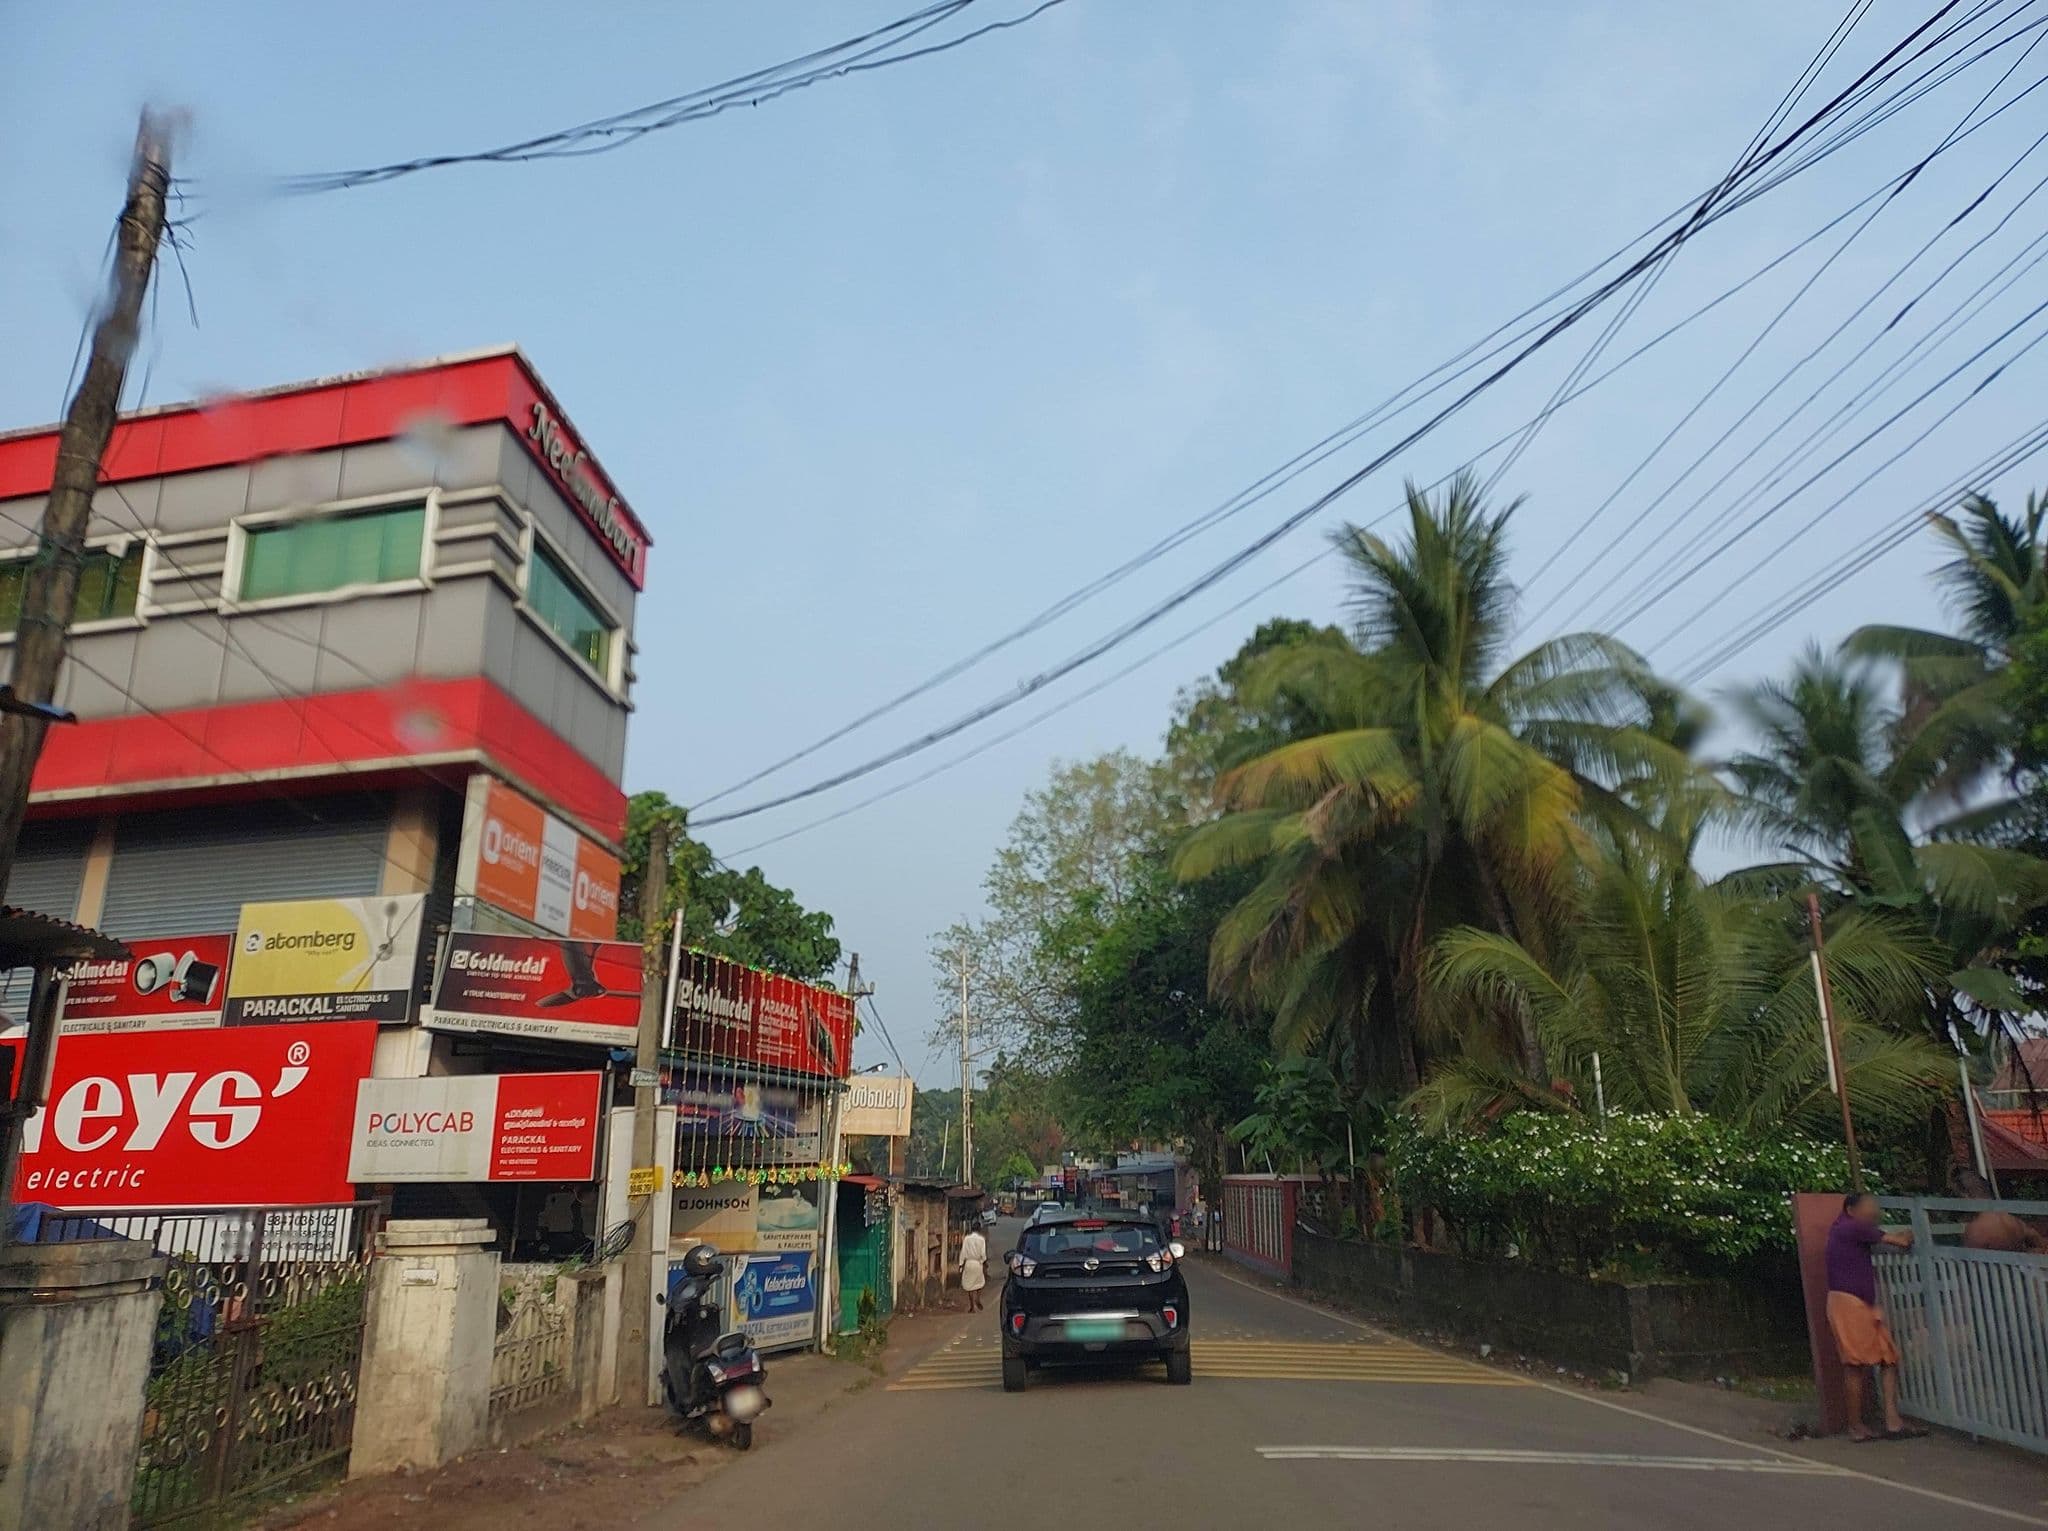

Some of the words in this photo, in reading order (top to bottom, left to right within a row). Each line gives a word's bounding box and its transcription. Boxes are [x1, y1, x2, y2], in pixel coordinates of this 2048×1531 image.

[265, 931, 355, 951] atomberg
[469, 952, 546, 975] Goldmedal
[242, 996, 334, 1018] PARACKAL
[336, 994, 382, 1004] ELECTRICALS
[335, 1004, 371, 1013] SANITARY
[693, 984, 752, 1022] Goldmedal
[63, 1021, 105, 1032] ELECTRICALS
[113, 1020, 146, 1030] SANITARY
[433, 1016, 468, 1027] PARACKAL
[470, 1018, 515, 1030] ELECTRICALS
[523, 1022, 559, 1033] SANITARY
[368, 1112, 474, 1134] POLYCAB
[366, 1139, 388, 1148] IDEAS
[501, 1136, 546, 1144] PARACKAL
[500, 1146, 541, 1154] ELECTRICALS
[549, 1145, 581, 1153] SANITARY
[26, 1163, 146, 1189] electric
[689, 1198, 750, 1210] JOHNSON
[763, 1233, 812, 1241] SANITARYWARE
